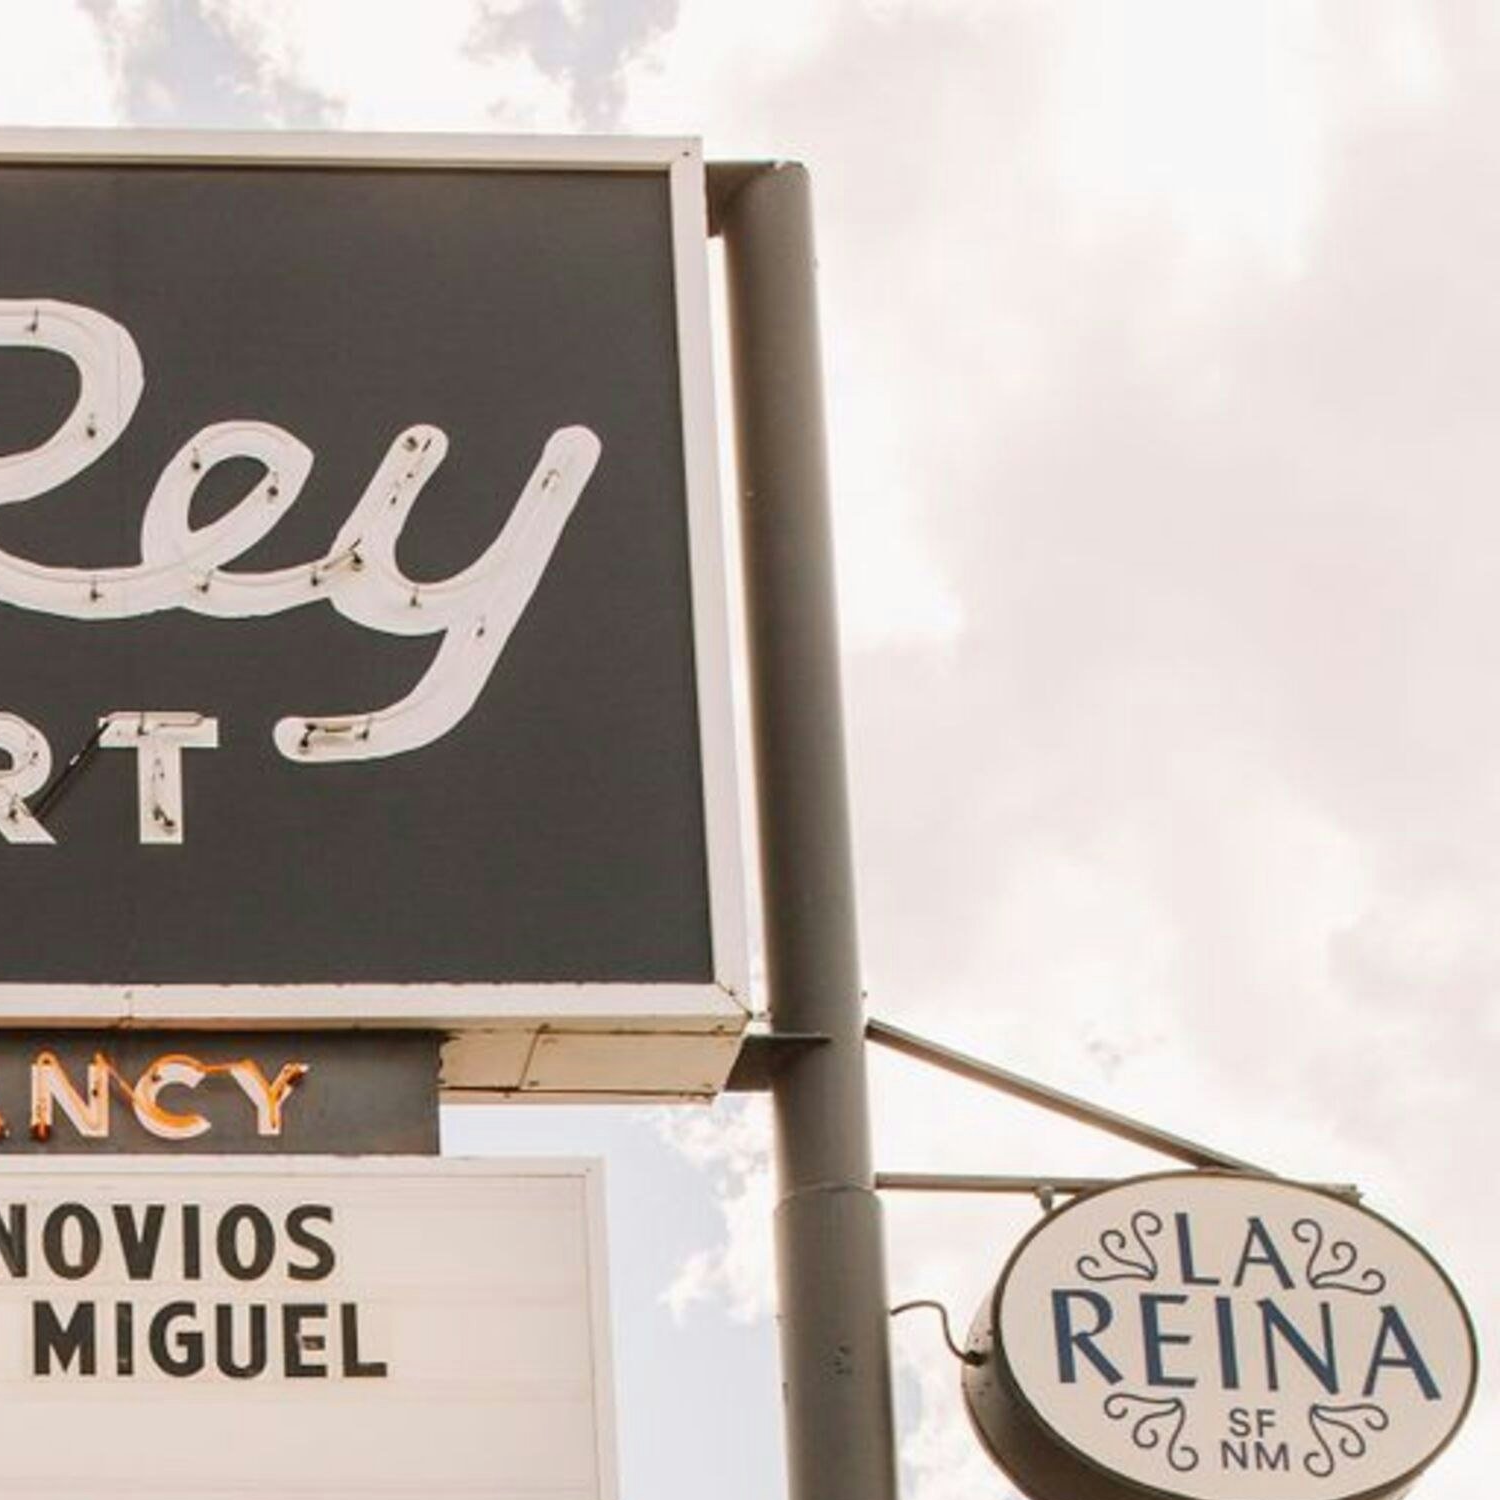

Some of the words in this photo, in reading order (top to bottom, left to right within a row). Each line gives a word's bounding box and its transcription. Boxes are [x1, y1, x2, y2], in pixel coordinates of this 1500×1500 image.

[1174, 1212, 1296, 1290] LA
[33, 1300, 389, 1380] MIGUEL
[1051, 1288, 1442, 1401] REINA
[1220, 1441, 1290, 1472] NM
[1228, 1407, 1277, 1438] SF
